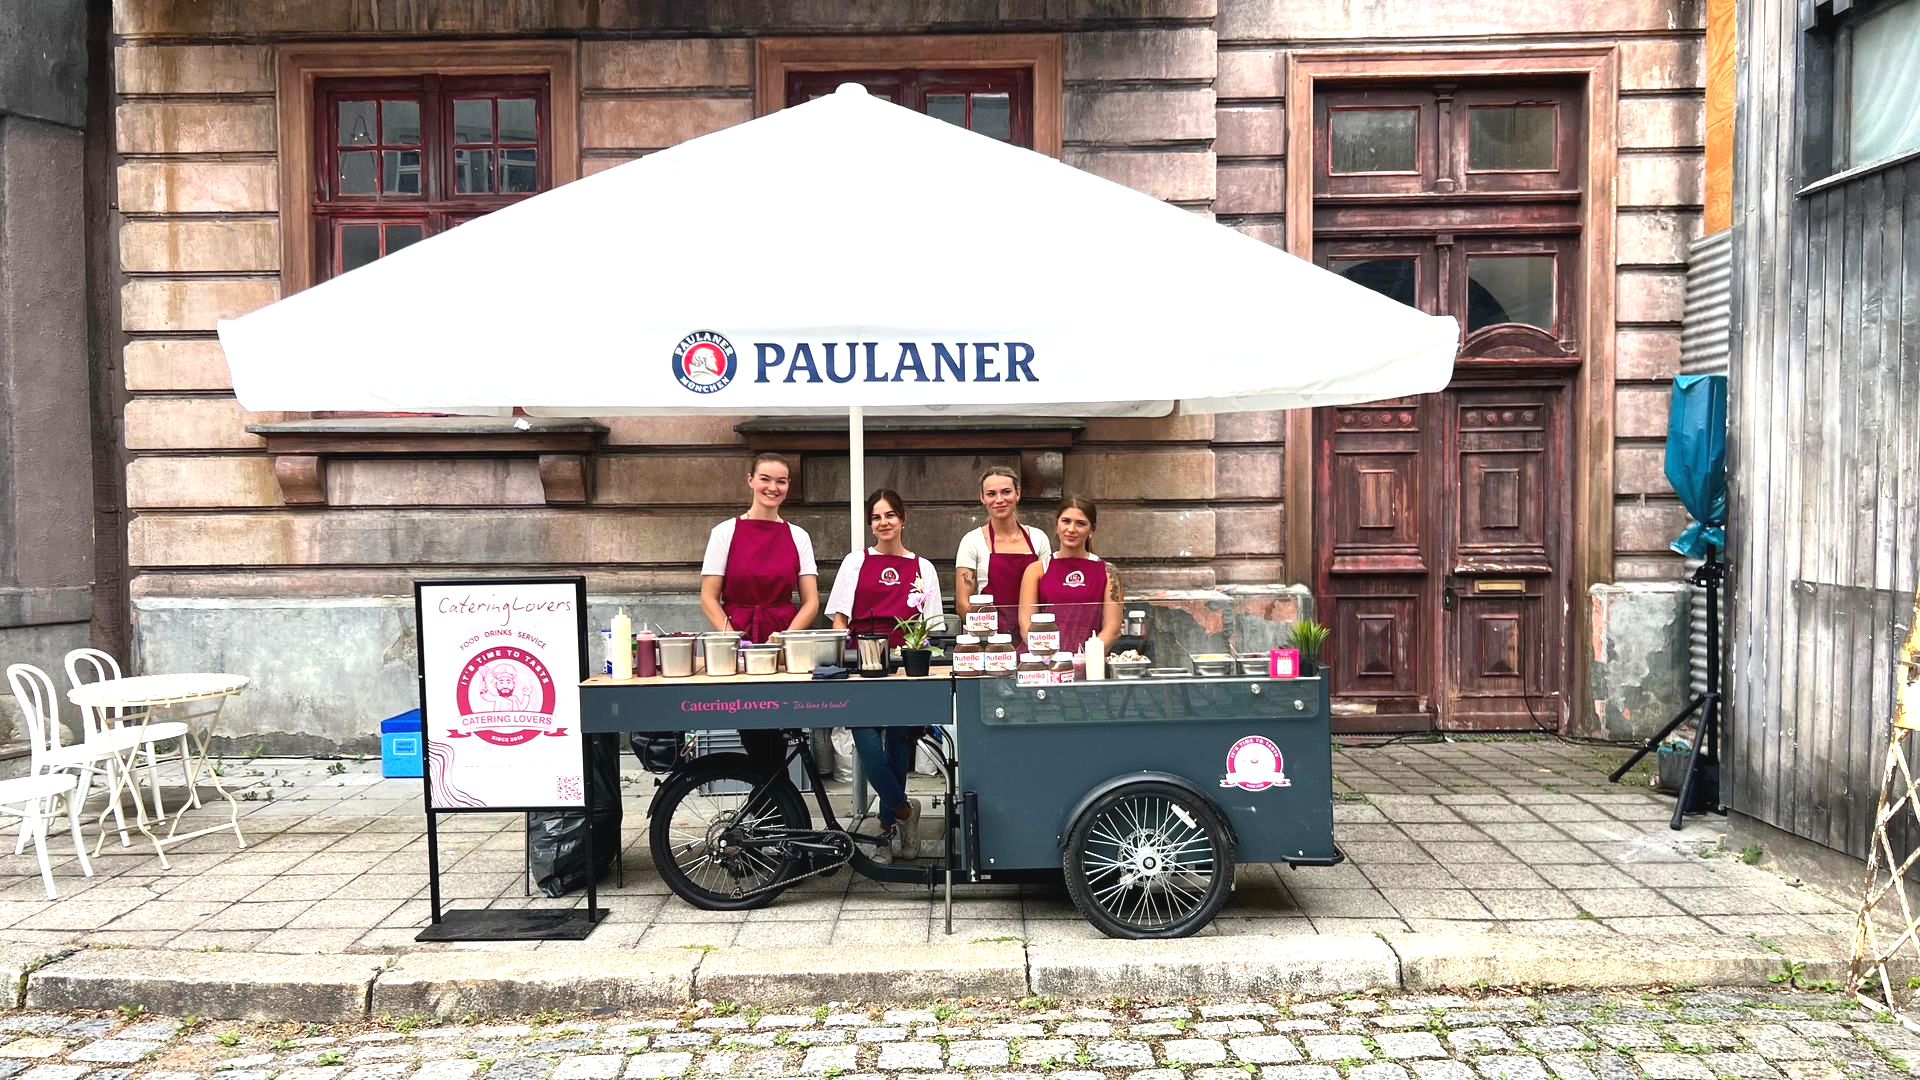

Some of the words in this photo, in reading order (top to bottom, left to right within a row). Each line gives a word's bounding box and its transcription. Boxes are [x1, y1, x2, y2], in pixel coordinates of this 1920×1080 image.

[675, 333, 734, 356] PAULANER
[753, 342, 1039, 383] PAULANER
[438, 594, 571, 626] CateringLovers
[969, 614, 995, 622] nutella
[460, 635, 480, 650] FOOD
[484, 629, 512, 638] DRINKS
[517, 631, 547, 649] SERVICE
[460, 664, 475, 686] IT'S
[476, 649, 501, 663] TIME
[506, 649, 520, 658] TO
[525, 655, 549, 684] TASTE
[681, 699, 780, 713] CateringLovers
[806, 701, 821, 709] time
[462, 714, 511, 726] CATERING
[514, 714, 552, 725] LOVERS
